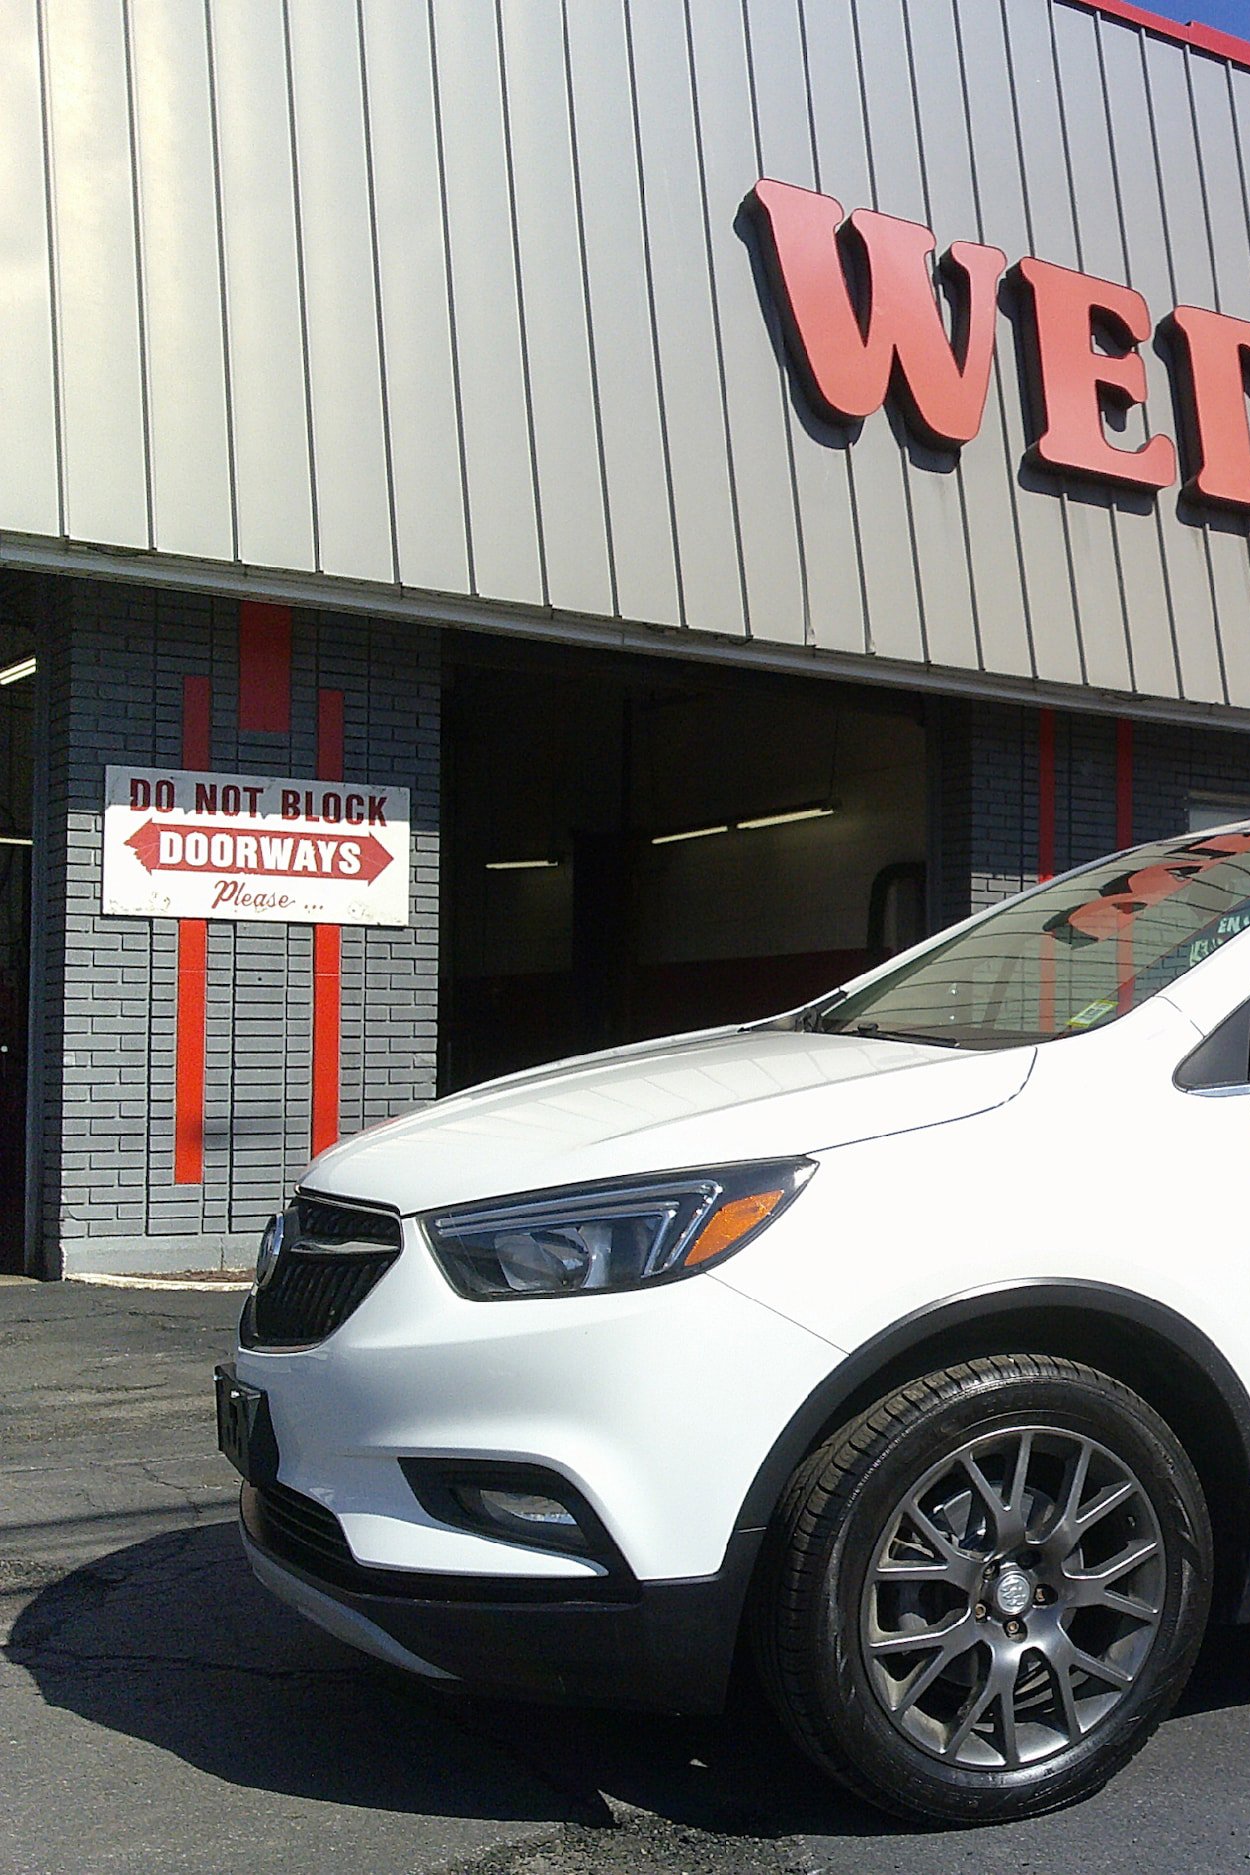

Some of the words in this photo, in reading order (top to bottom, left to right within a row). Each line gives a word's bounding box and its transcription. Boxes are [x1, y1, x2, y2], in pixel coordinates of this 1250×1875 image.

[130, 778, 175, 812] DO
[195, 783, 264, 817] NOT
[281, 789, 387, 826] BLOCK
[159, 831, 361, 874] DOORWAYS
[211, 880, 296, 910] Please
